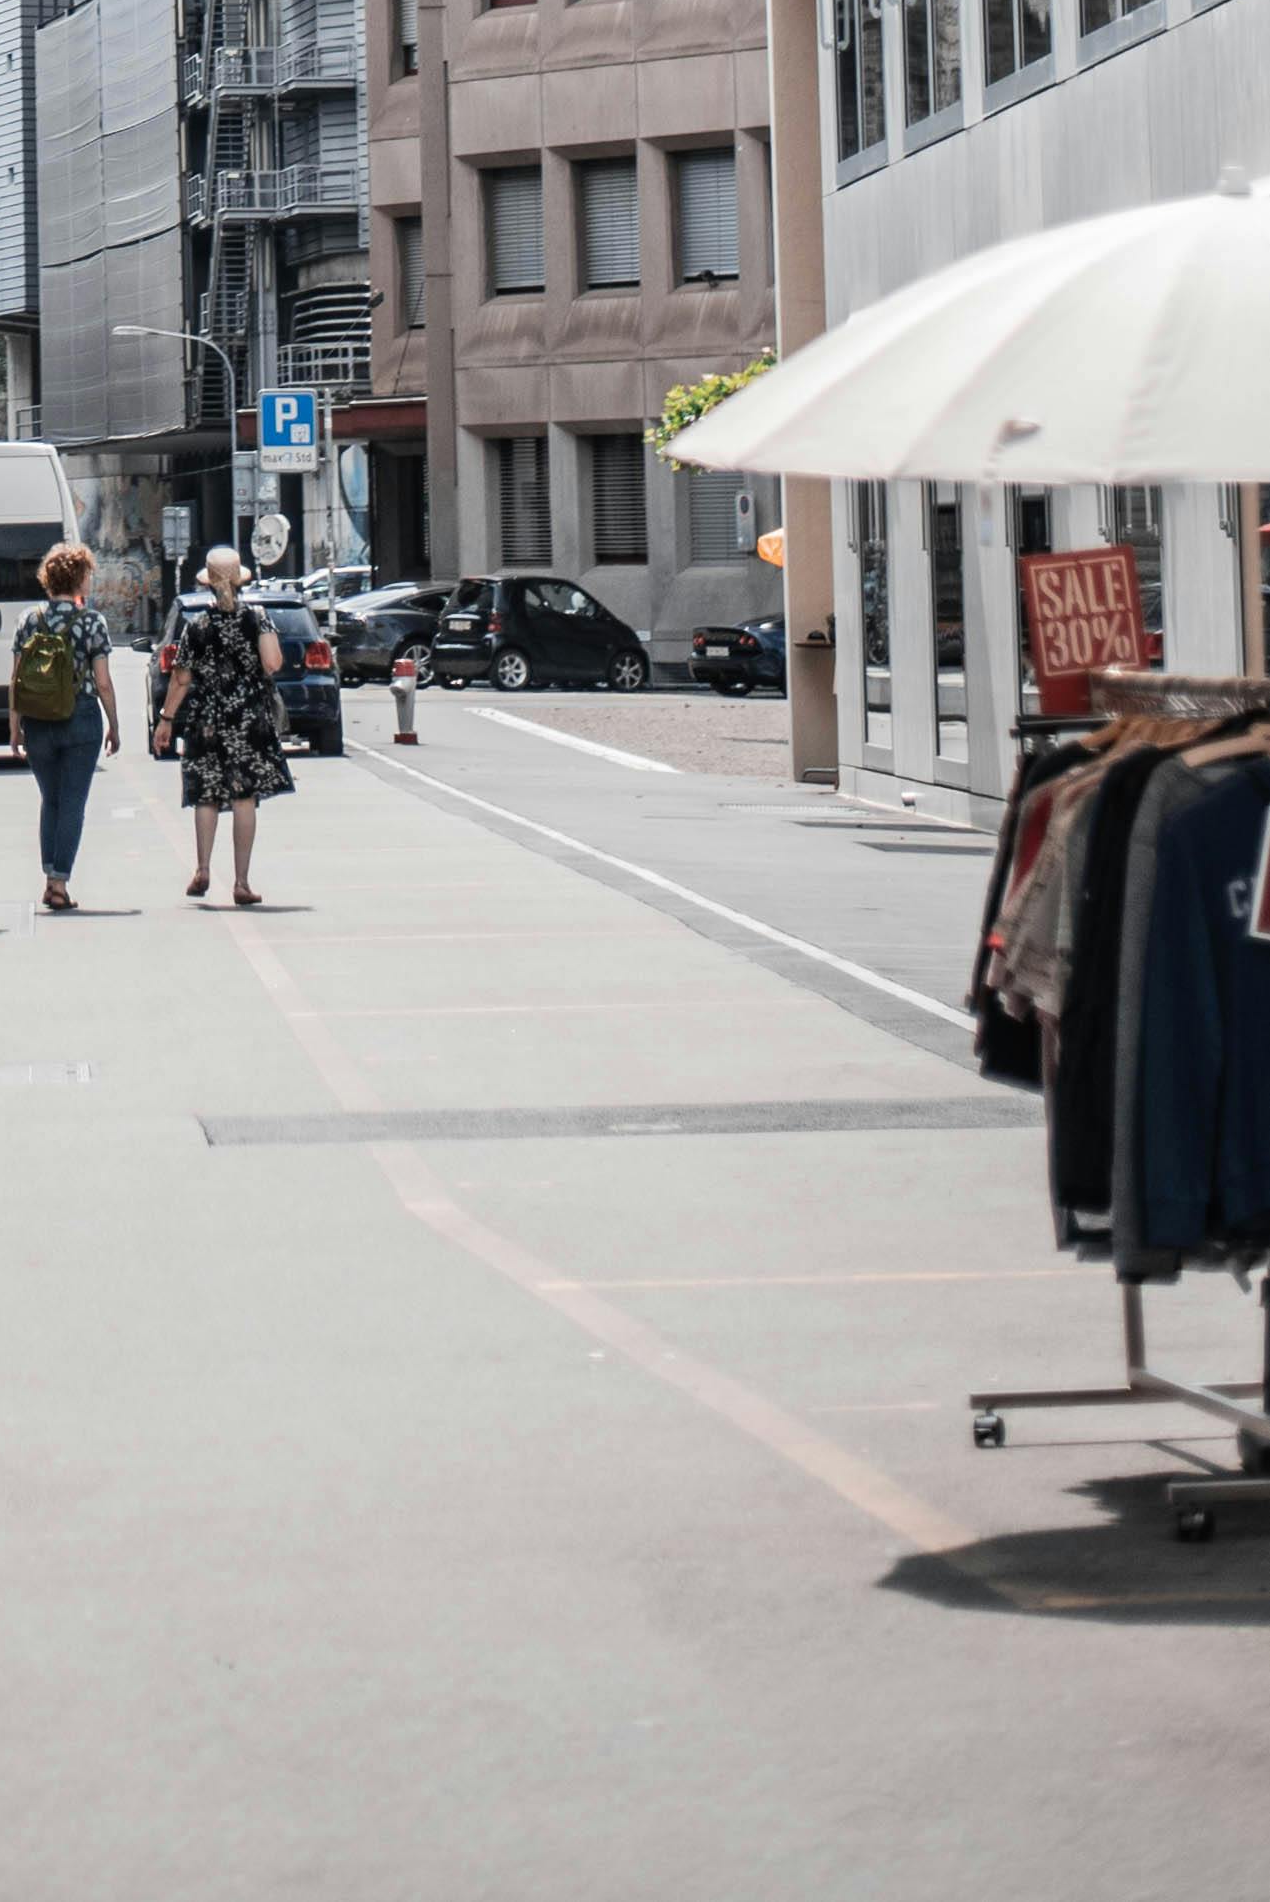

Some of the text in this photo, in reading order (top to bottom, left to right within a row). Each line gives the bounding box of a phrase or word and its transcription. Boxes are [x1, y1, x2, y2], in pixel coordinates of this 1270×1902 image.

[274, 396, 299, 434] P
[1037, 562, 1126, 619] SALE
[1045, 613, 1132, 669] 30%
